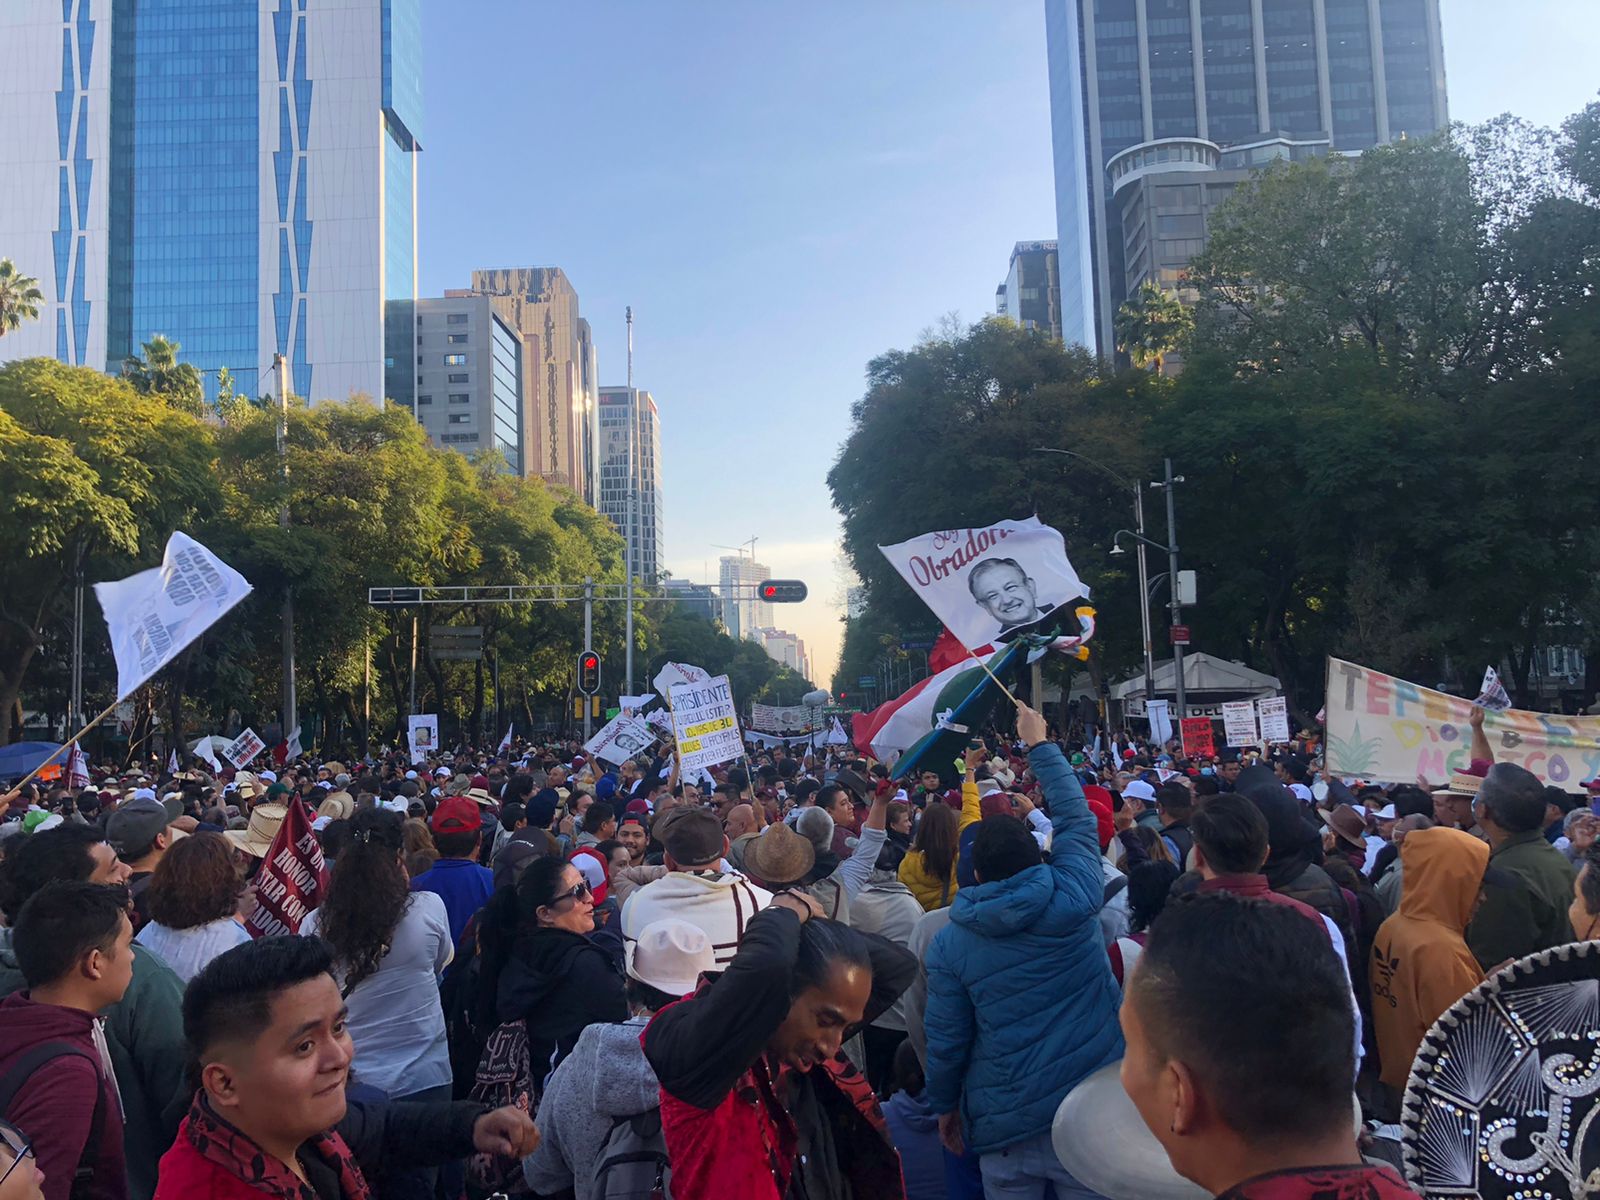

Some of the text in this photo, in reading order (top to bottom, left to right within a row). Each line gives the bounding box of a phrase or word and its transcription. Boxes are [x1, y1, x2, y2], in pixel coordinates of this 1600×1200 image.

[296, 831, 317, 855] ES
[273, 847, 317, 896] HONOR
[281, 893, 309, 924] CON
